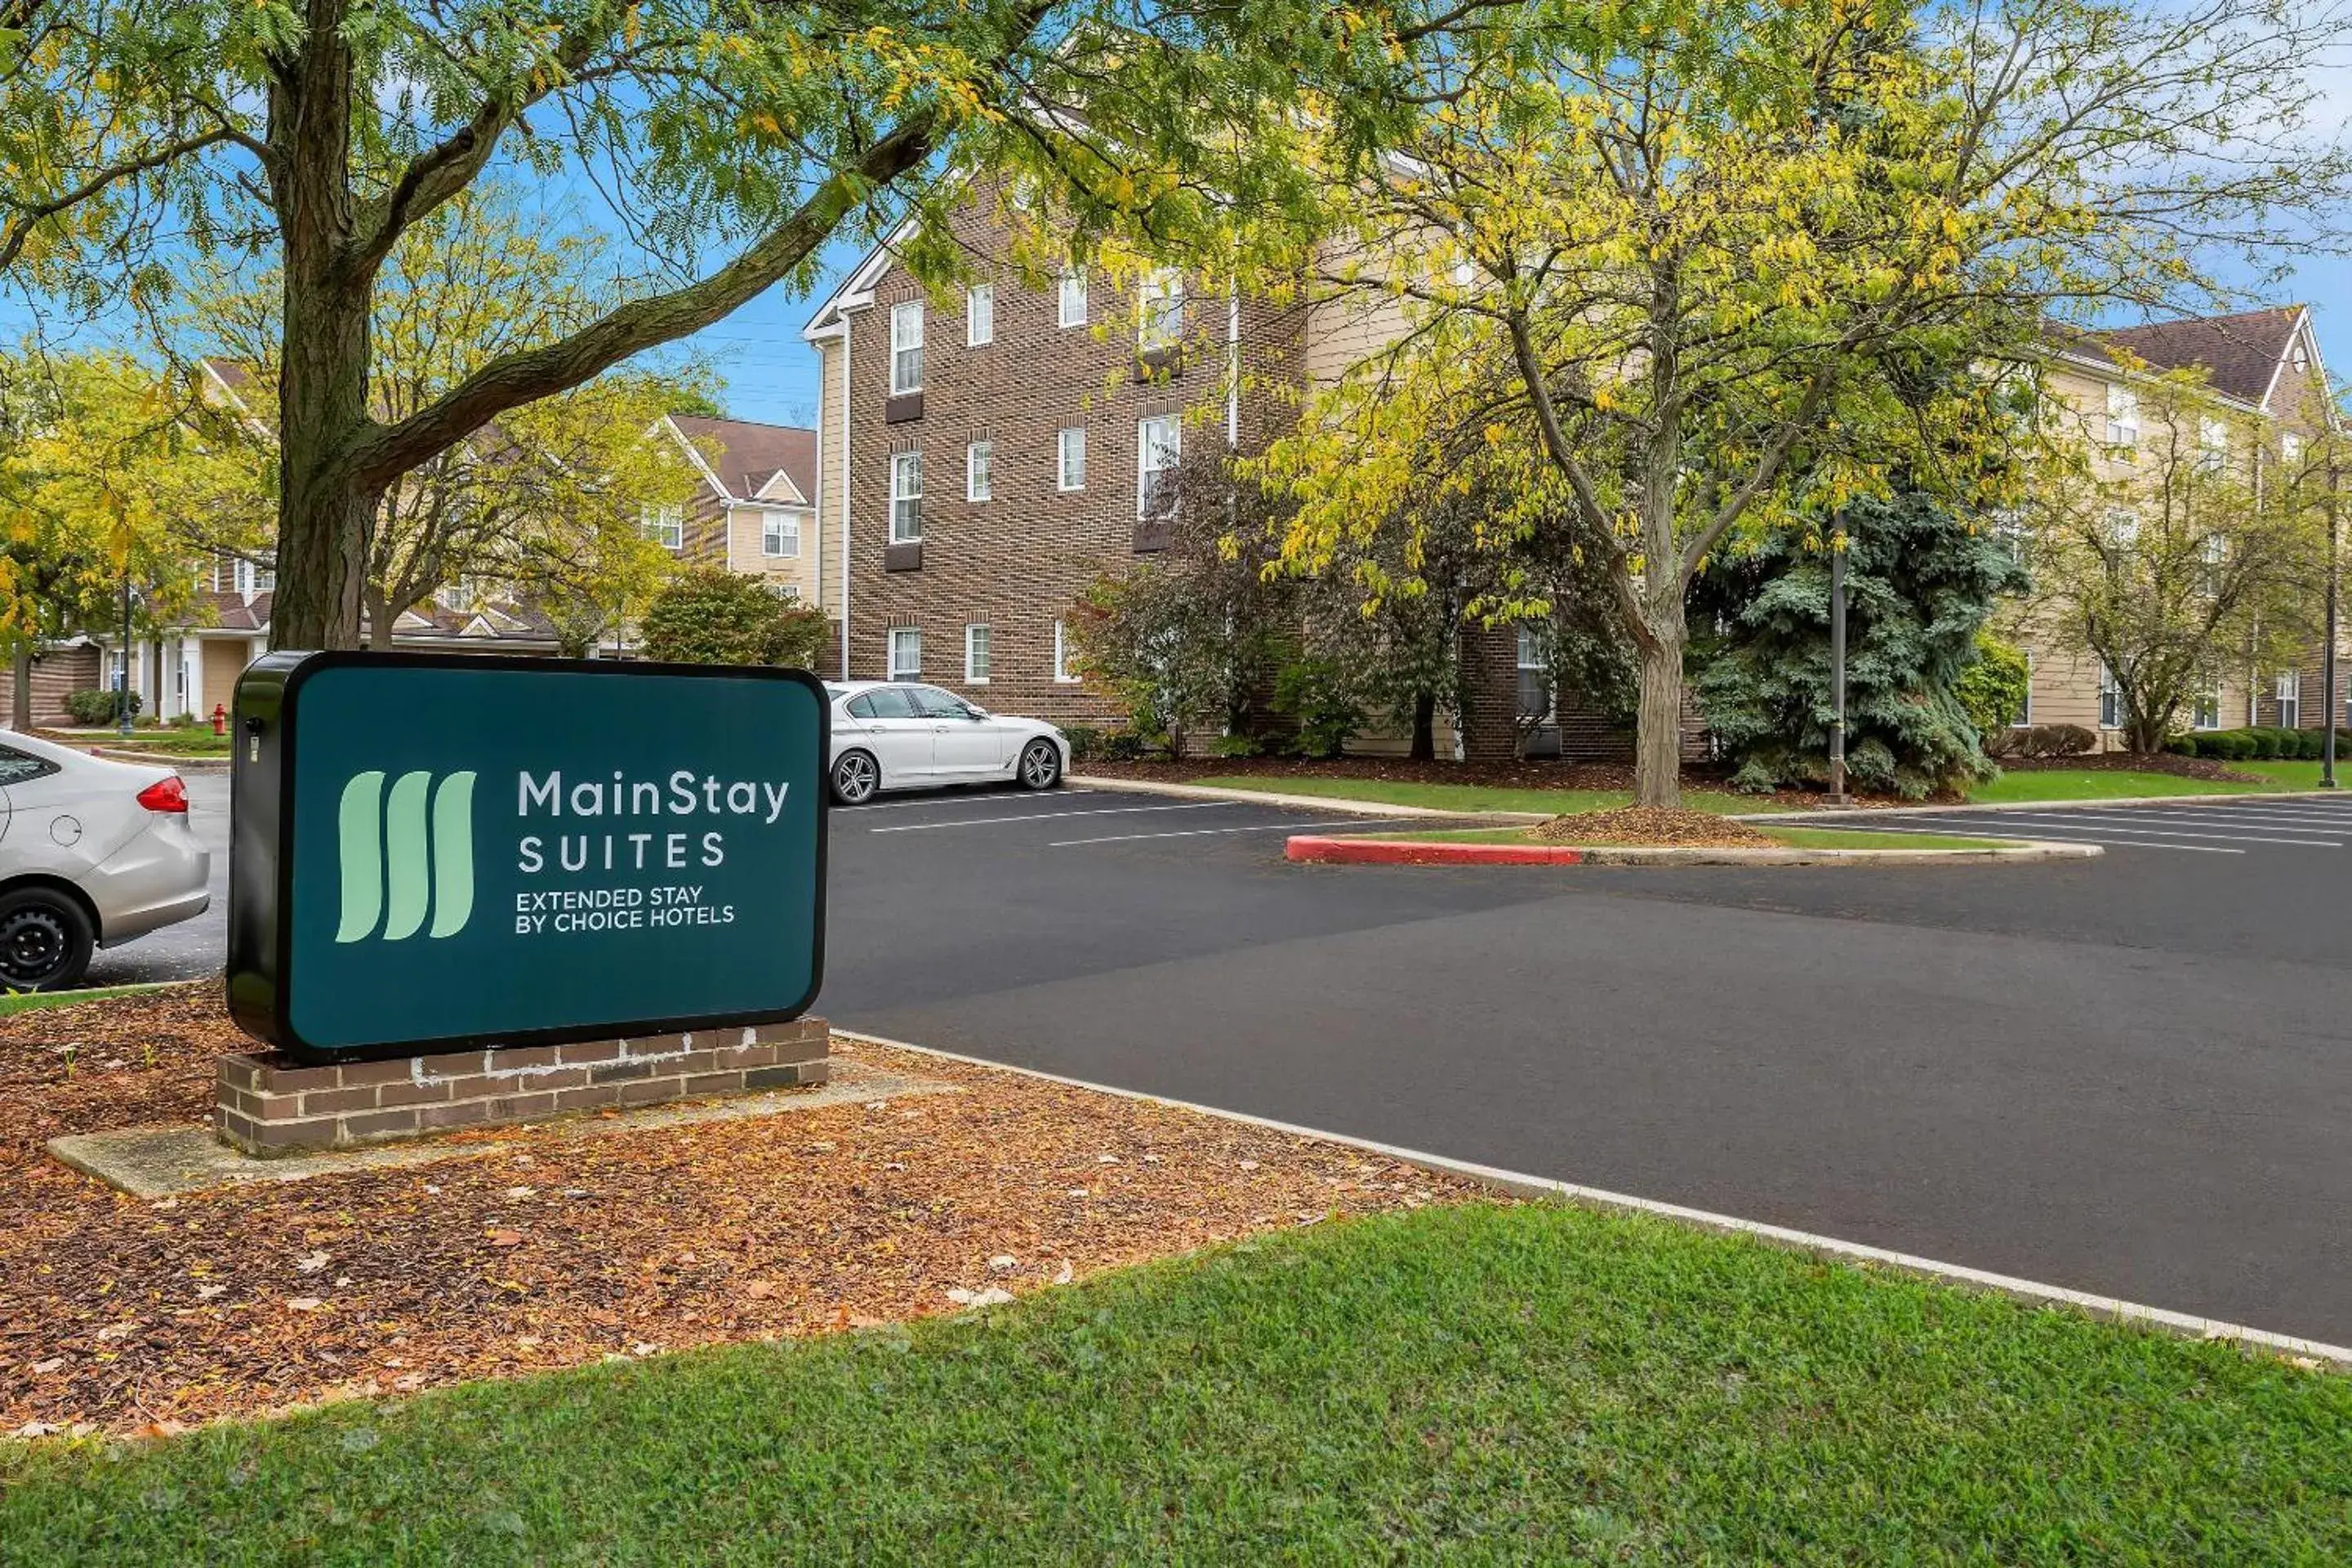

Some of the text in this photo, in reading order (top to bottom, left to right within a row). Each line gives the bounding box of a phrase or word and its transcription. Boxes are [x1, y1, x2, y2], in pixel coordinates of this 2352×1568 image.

[518, 770, 790, 824] MainStay
[518, 832, 724, 873] SUITES
[516, 885, 703, 912] EXTENDED STAY
[515, 905, 735, 934] BY CHOICE HOTELS
